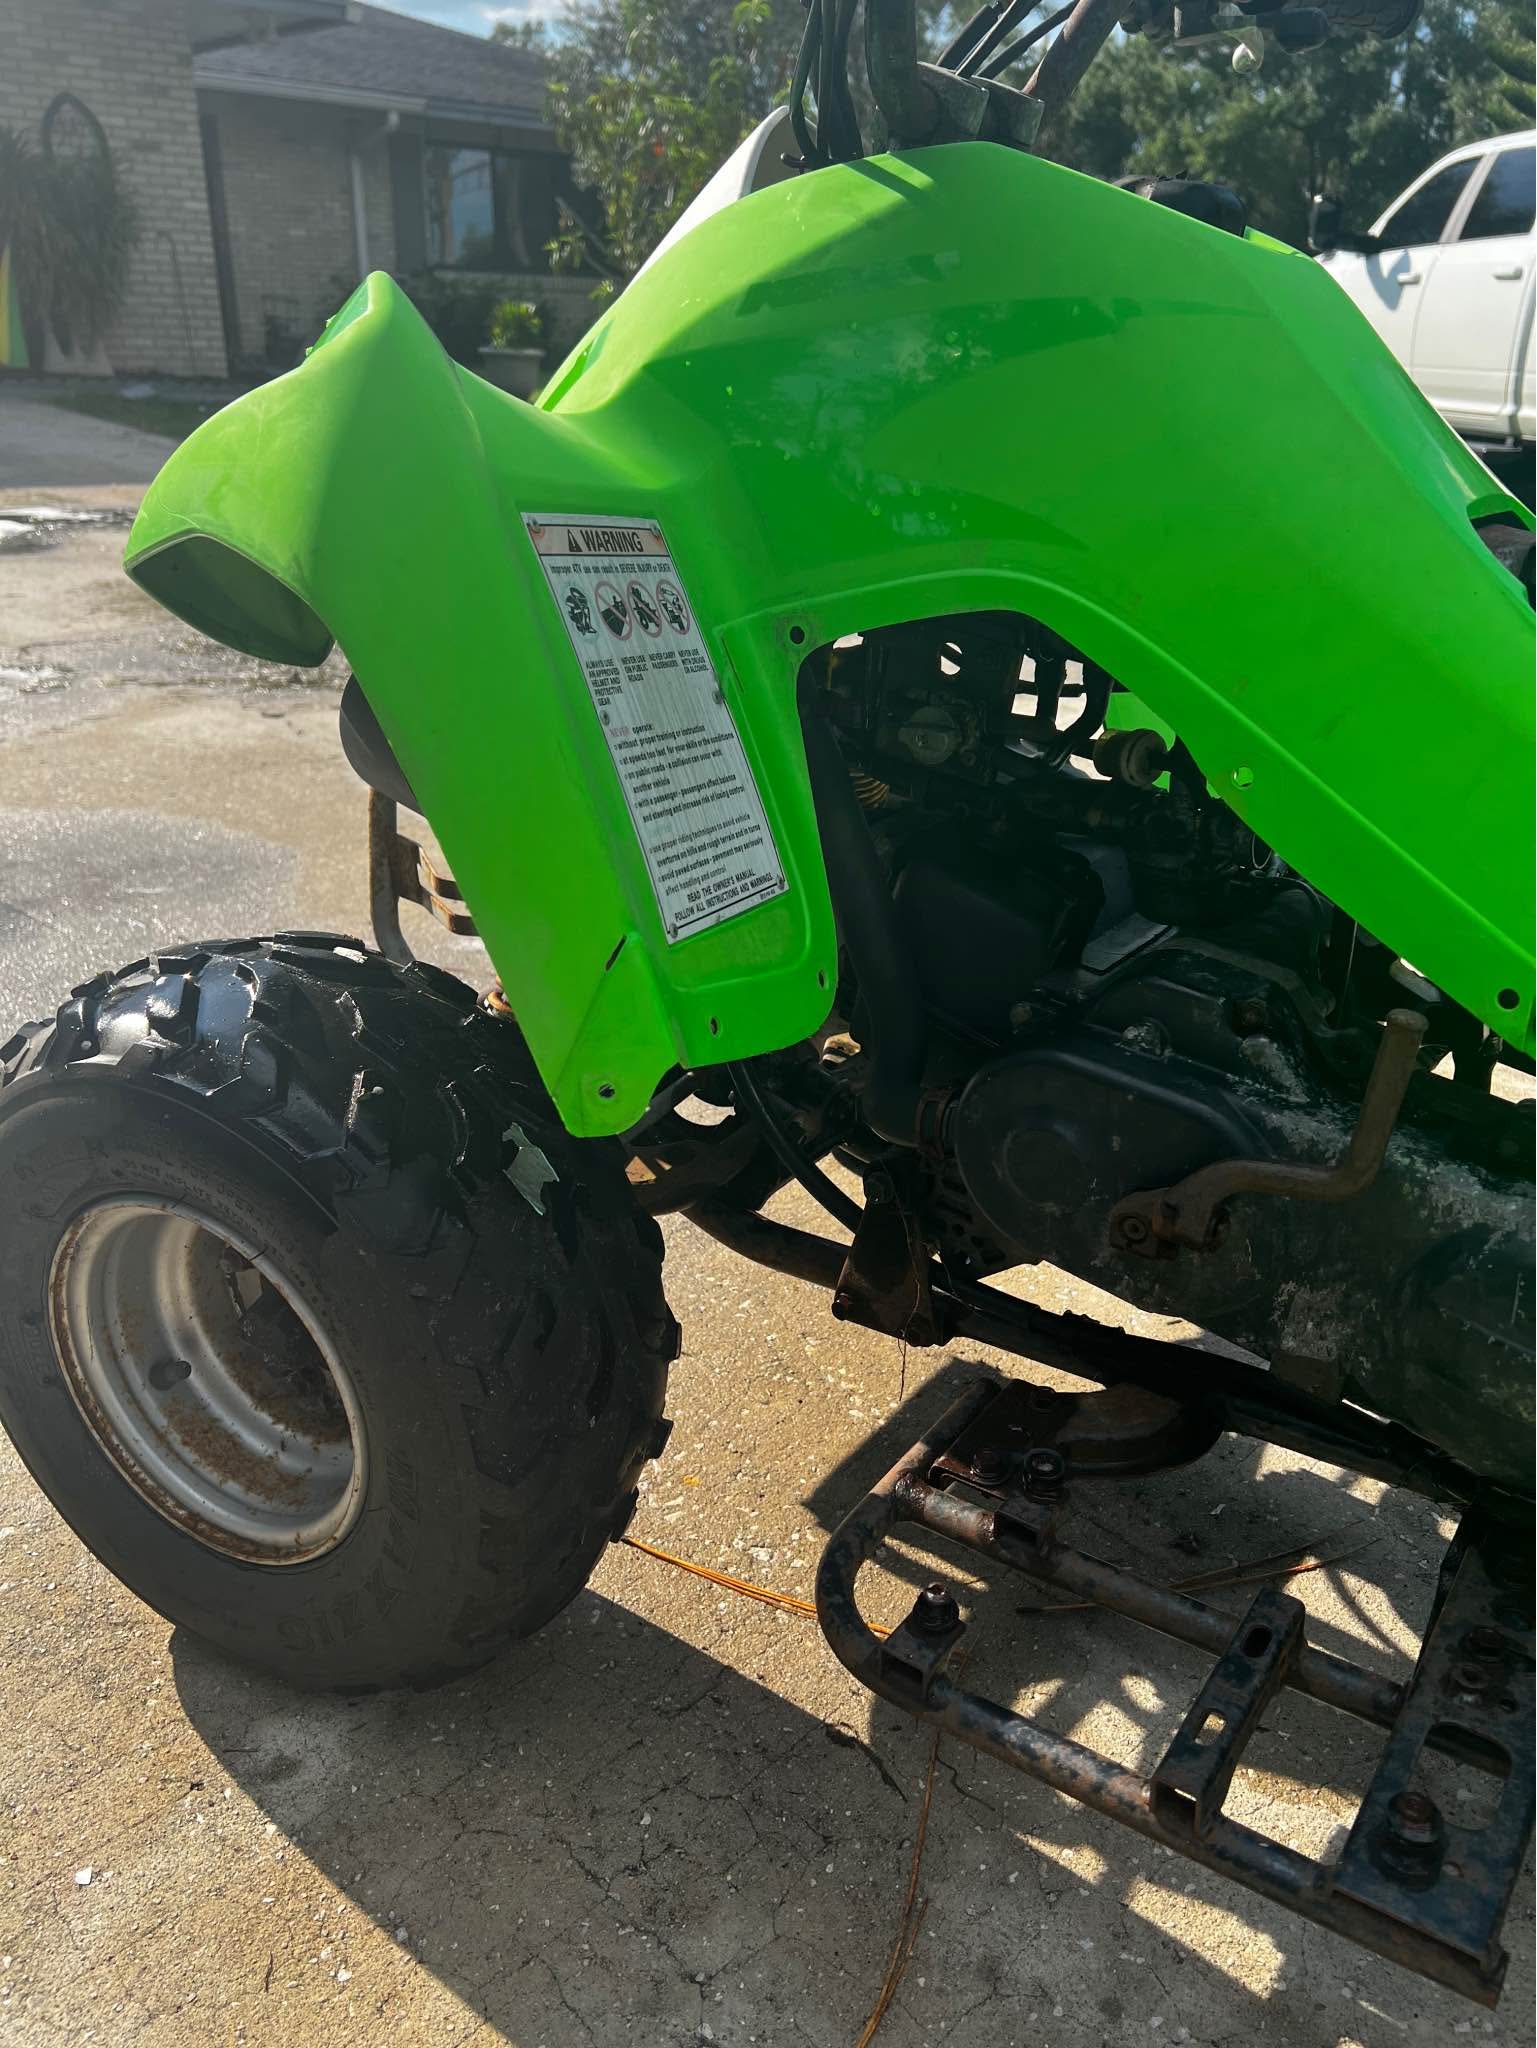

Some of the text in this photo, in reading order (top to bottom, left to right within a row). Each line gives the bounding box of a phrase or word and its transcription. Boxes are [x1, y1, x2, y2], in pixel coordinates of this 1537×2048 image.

[580, 529, 644, 552] WARNING
[621, 654, 646, 665] NEVER USE
[649, 652, 676, 661] NEVER CARRY
[678, 650, 691, 658] NEVER
[586, 658, 614, 669] ALWAYS USE
[632, 664, 648, 672] PUBLIC
[652, 660, 678, 669] PASSENGERS
[596, 668, 620, 678] APPROVED
[628, 673, 644, 682] ROADS
[591, 676, 620, 688] HELMET AND
[594, 686, 624, 697] PROTECTIVE
[598, 697, 611, 706] GEAR
[618, 739, 638, 750] without
[639, 736, 656, 747] proper
[656, 731, 676, 740] training
[629, 752, 646, 764] speeds
[636, 766, 651, 780] public
[651, 762, 666, 773] roads
[633, 778, 670, 794] another vehicle
[638, 799, 650, 808] with
[643, 812, 652, 823] and
[652, 808, 673, 820] steering
[673, 803, 682, 814] and
[662, 870, 674, 882] avoid
[674, 864, 690, 878] paved
[712, 848, 734, 862] pavement
[687, 890, 701, 903] READ
[702, 886, 712, 897] THE
[713, 876, 734, 892] OWNER'S
[674, 872, 772, 922] FOLLOW ALL INSTRUCTIONS AND WARNINGS
